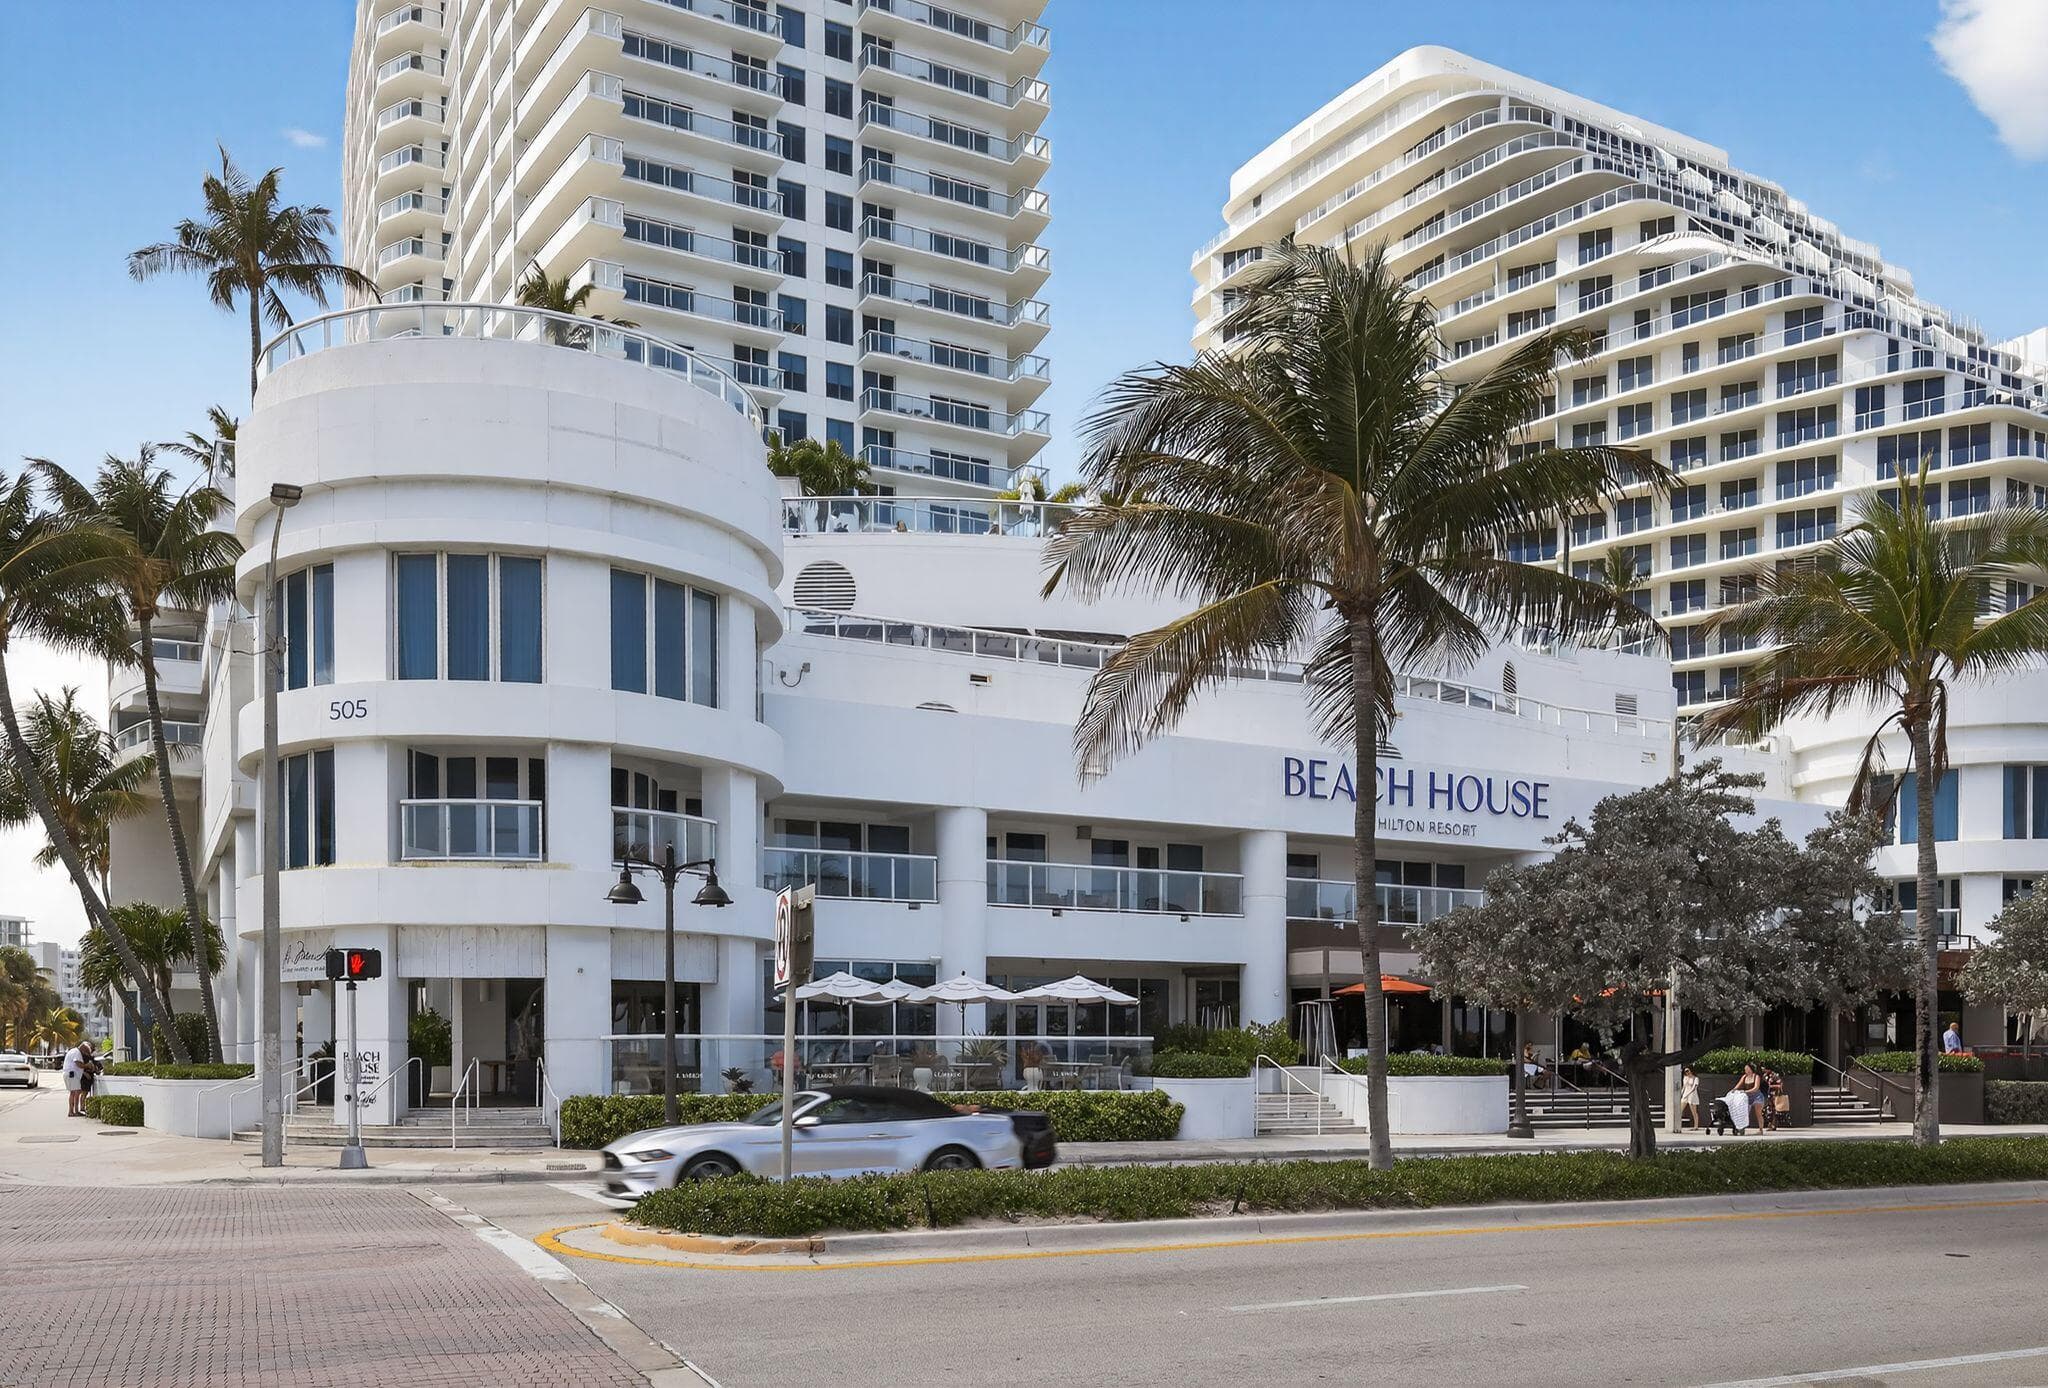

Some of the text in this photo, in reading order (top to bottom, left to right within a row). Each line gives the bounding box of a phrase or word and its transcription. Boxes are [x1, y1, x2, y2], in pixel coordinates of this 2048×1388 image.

[329, 699, 368, 721] 505
[1428, 771, 1550, 820] HOUSE
[1377, 817, 1478, 837] HILTON RESORT
[343, 1051, 380, 1062] BACH
[359, 1062, 380, 1074] USE
